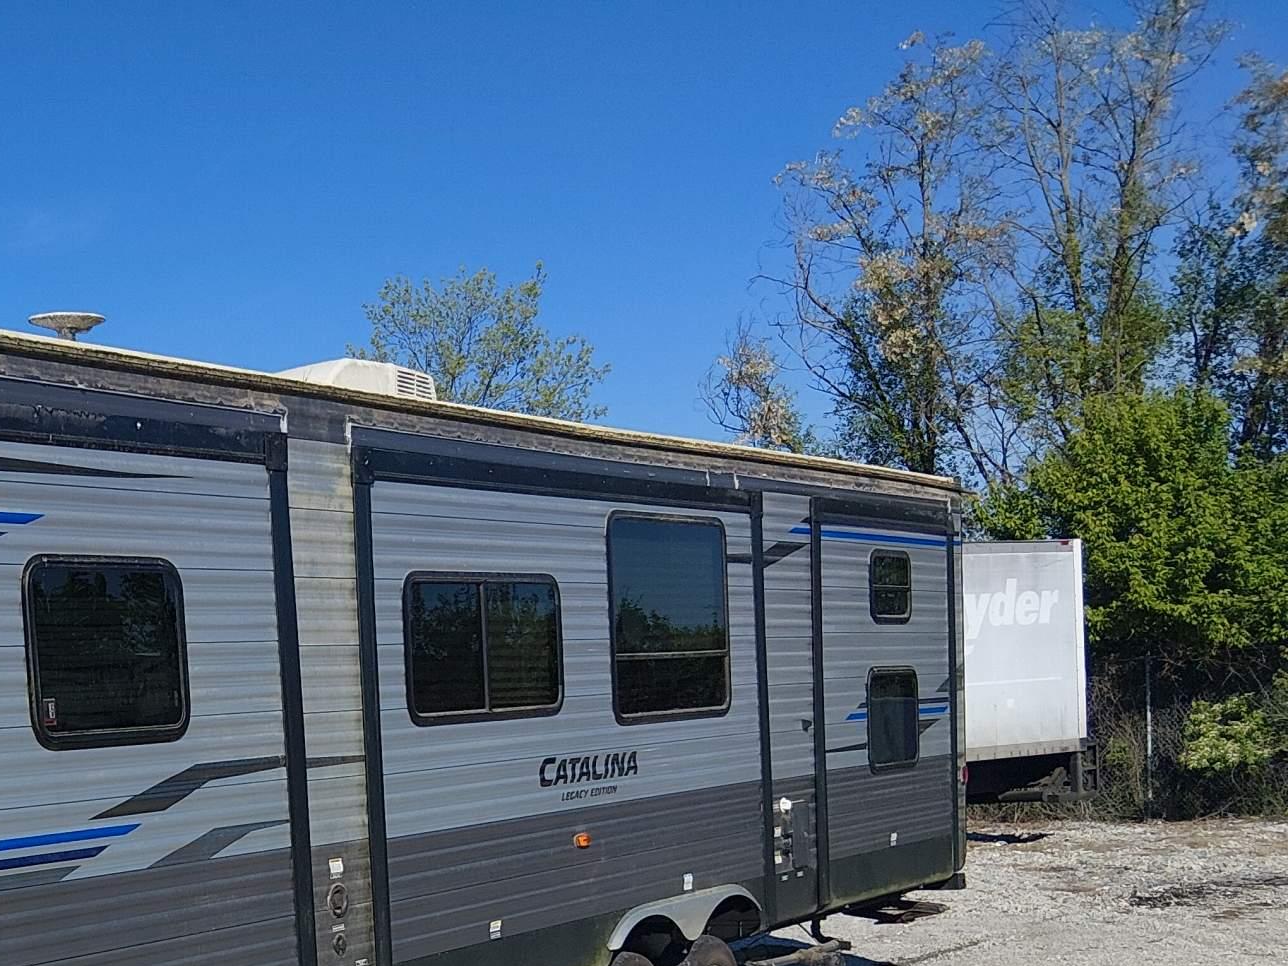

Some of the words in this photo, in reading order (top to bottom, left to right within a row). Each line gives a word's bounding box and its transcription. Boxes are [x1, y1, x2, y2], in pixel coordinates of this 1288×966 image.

[963, 577, 1060, 640] yder
[538, 750, 639, 788] CATALINA
[560, 788, 590, 802] LEGACY
[589, 784, 618, 797] EDITION
